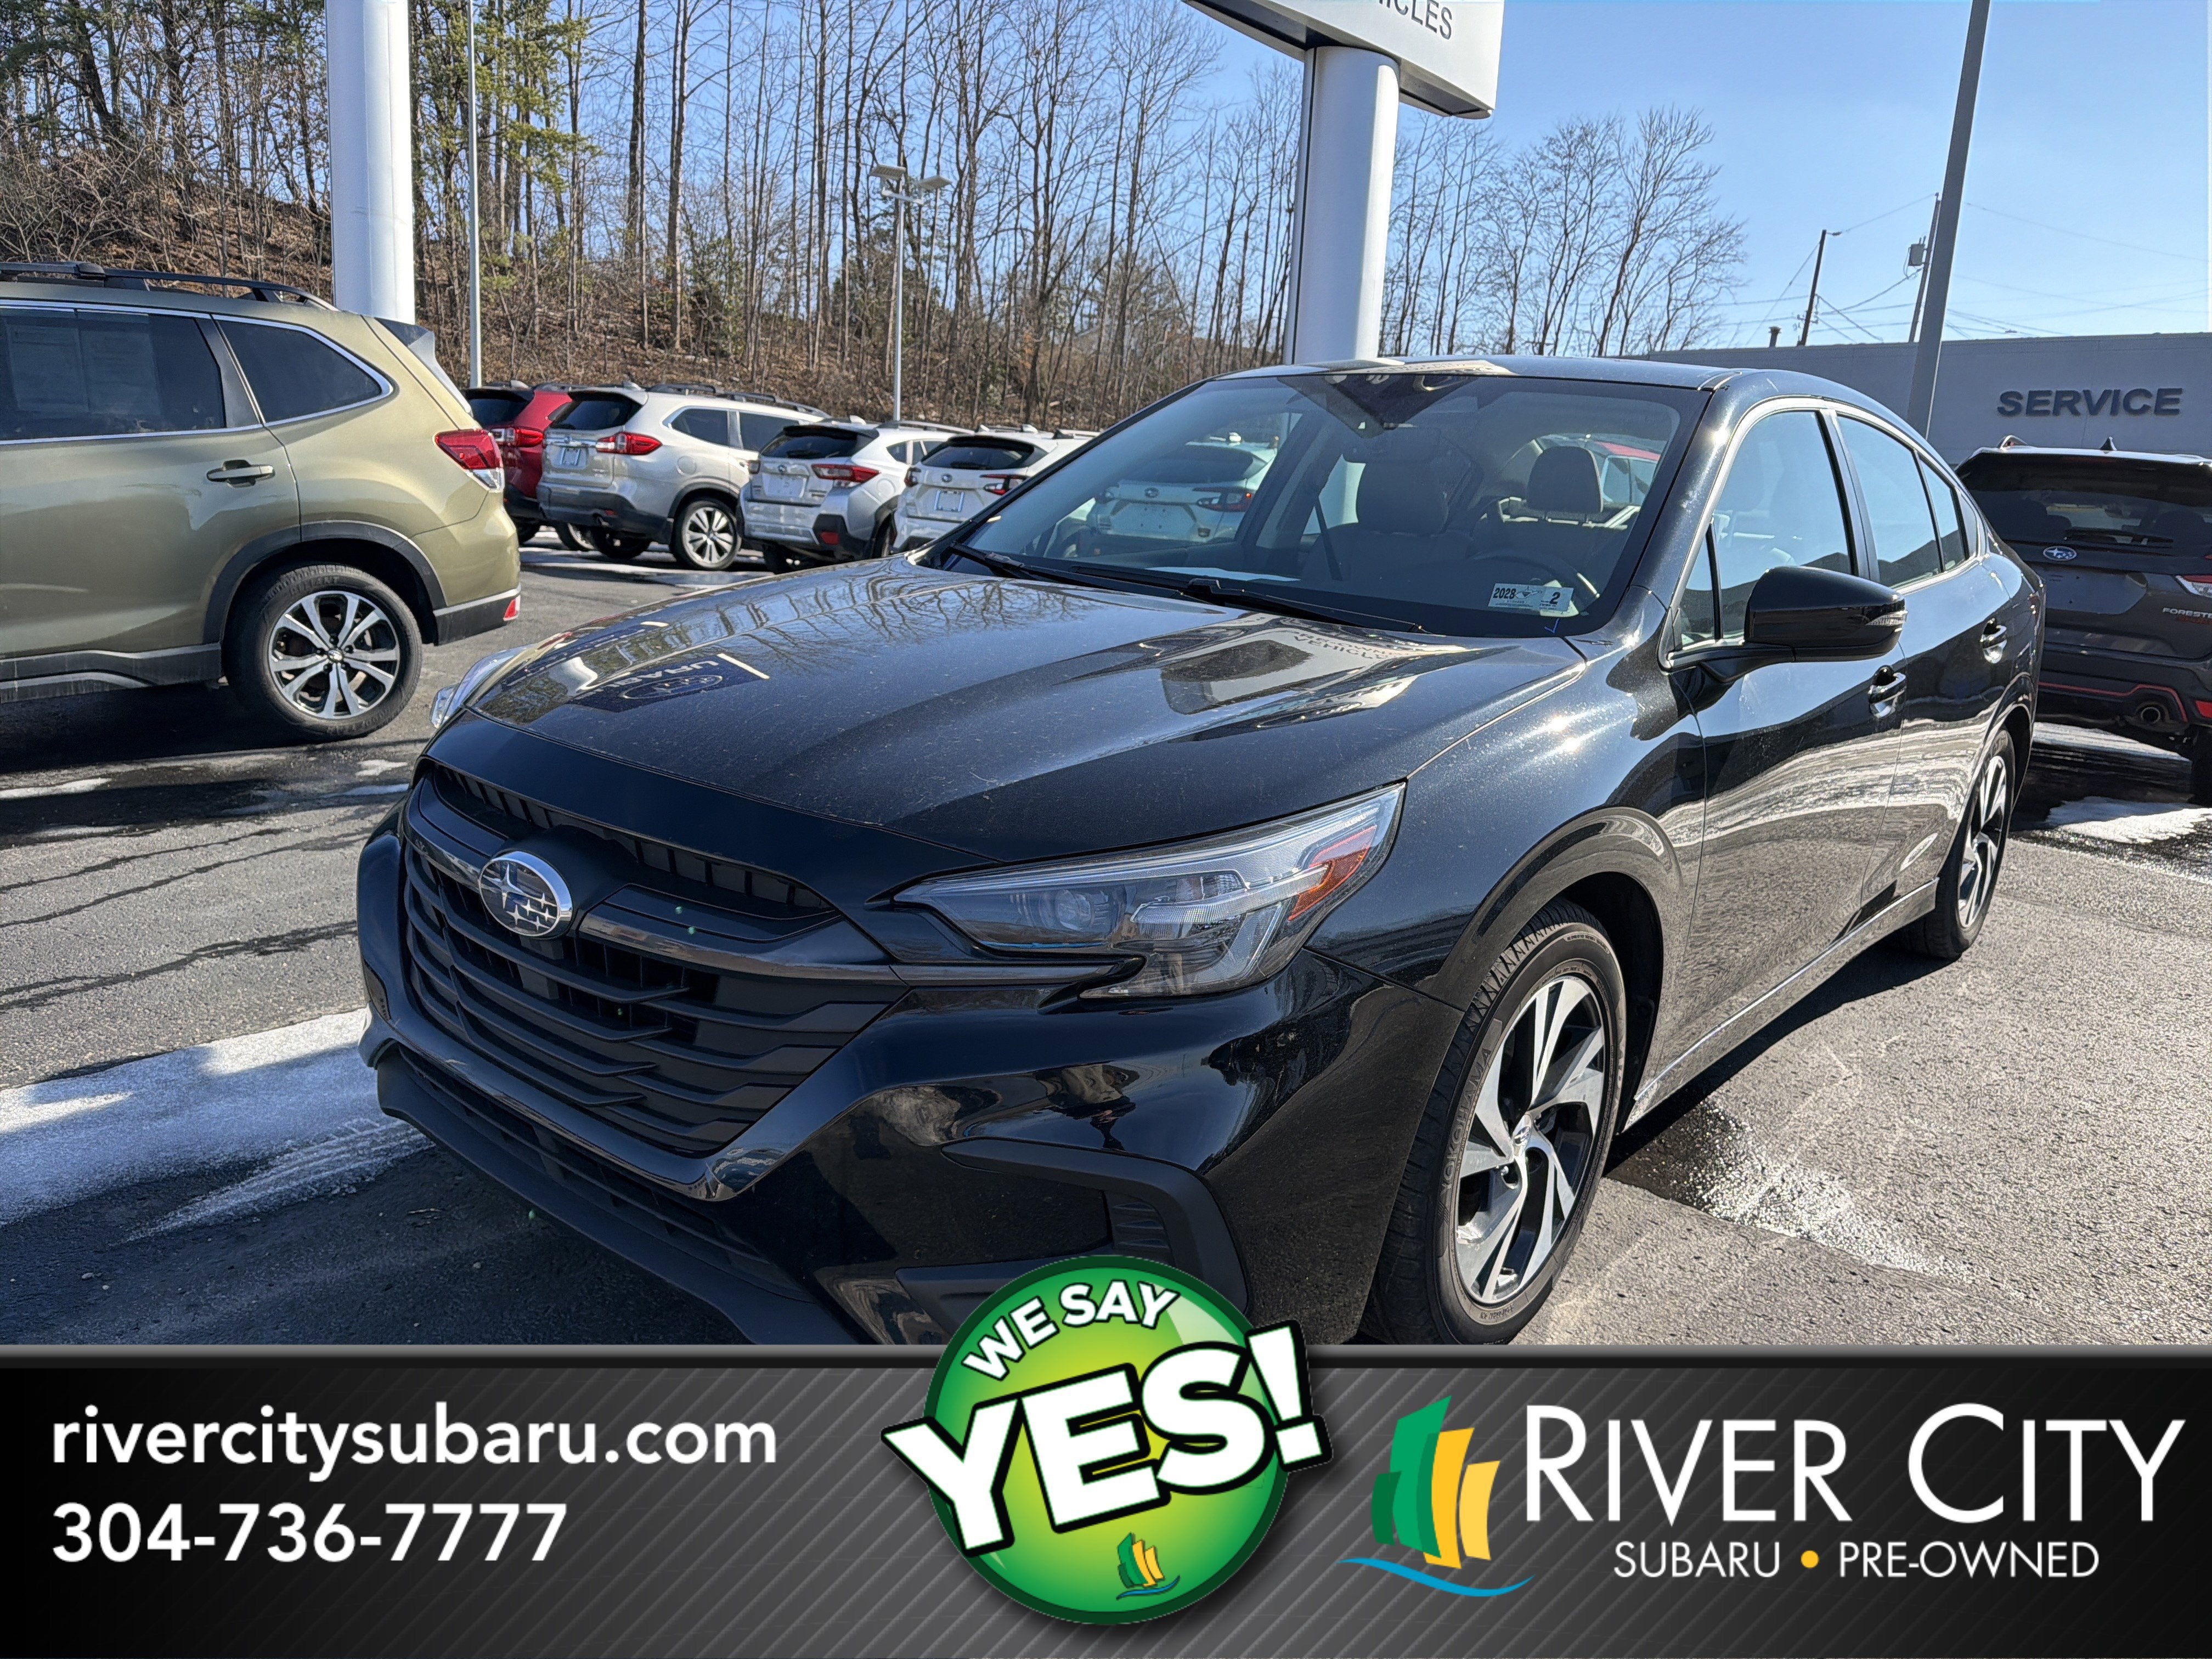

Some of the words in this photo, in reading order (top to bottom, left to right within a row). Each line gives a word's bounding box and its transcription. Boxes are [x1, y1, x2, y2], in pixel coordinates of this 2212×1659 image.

[1997, 387, 2182, 417] SERVICE
[1493, 587, 1516, 600] 2028
[1550, 591, 1561, 605] 2
[1440, 1047, 1492, 1196] YOKOHAMA
